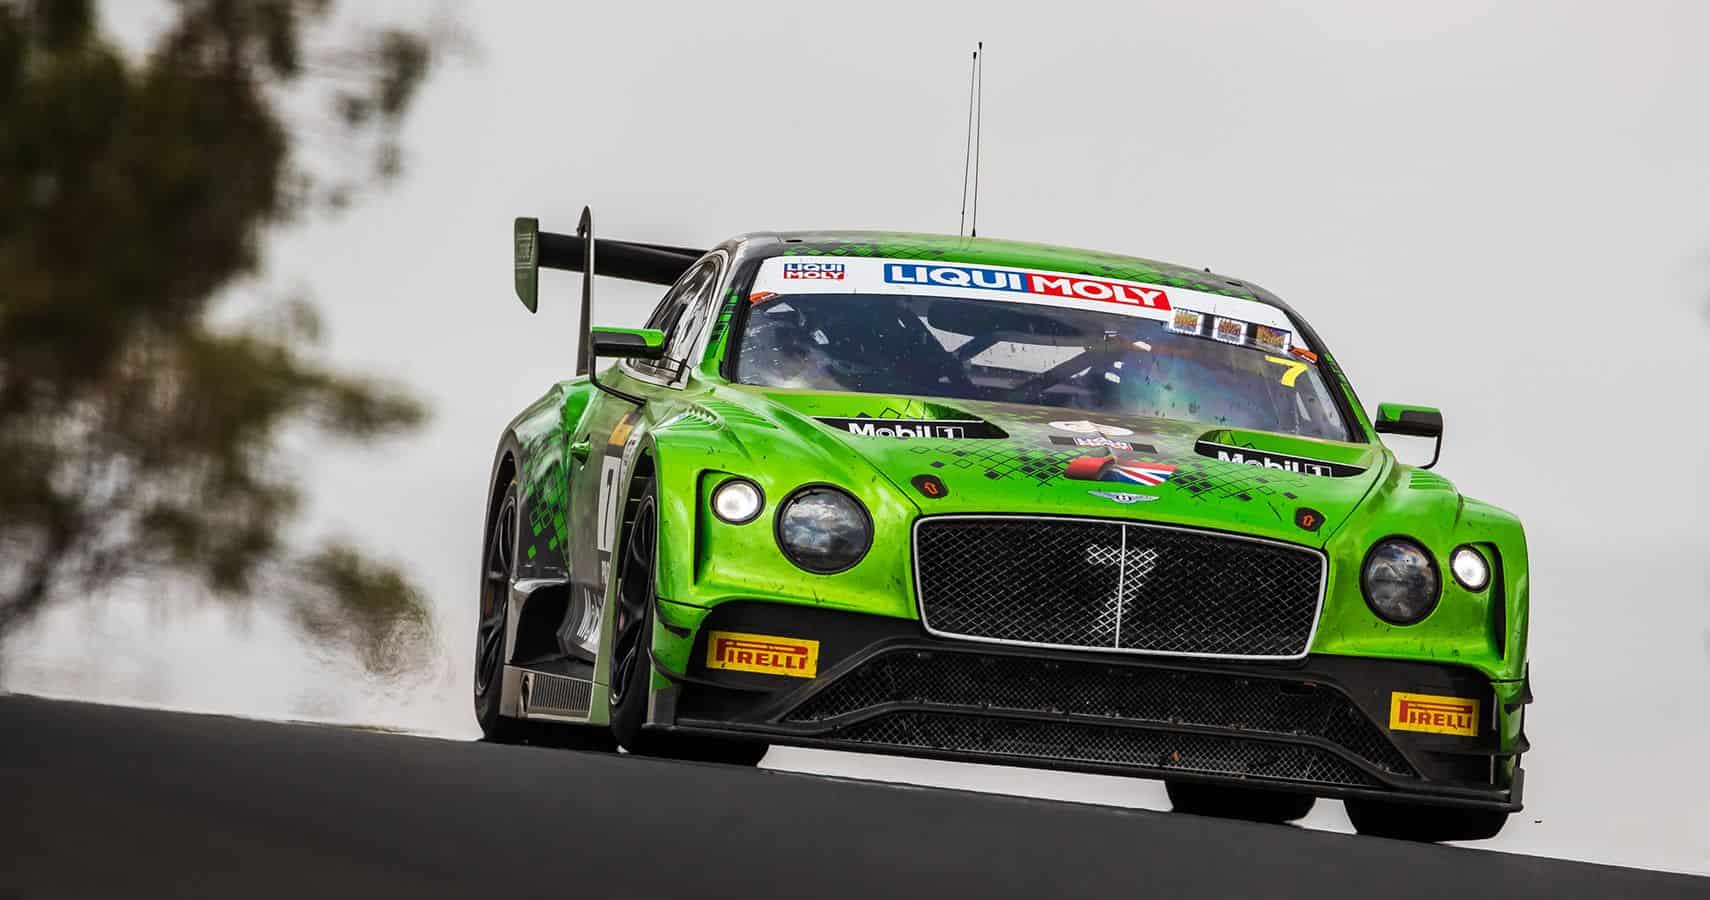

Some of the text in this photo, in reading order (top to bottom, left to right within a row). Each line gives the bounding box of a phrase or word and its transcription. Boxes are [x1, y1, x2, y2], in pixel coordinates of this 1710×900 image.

[785, 263, 844, 272] LIQUI
[785, 271, 846, 281] MOLY
[891, 265, 1163, 307] LIQUI MOLY
[1265, 354, 1309, 388] 7
[715, 638, 808, 670] PIRELLI
[1399, 700, 1473, 729] PIRELLI
